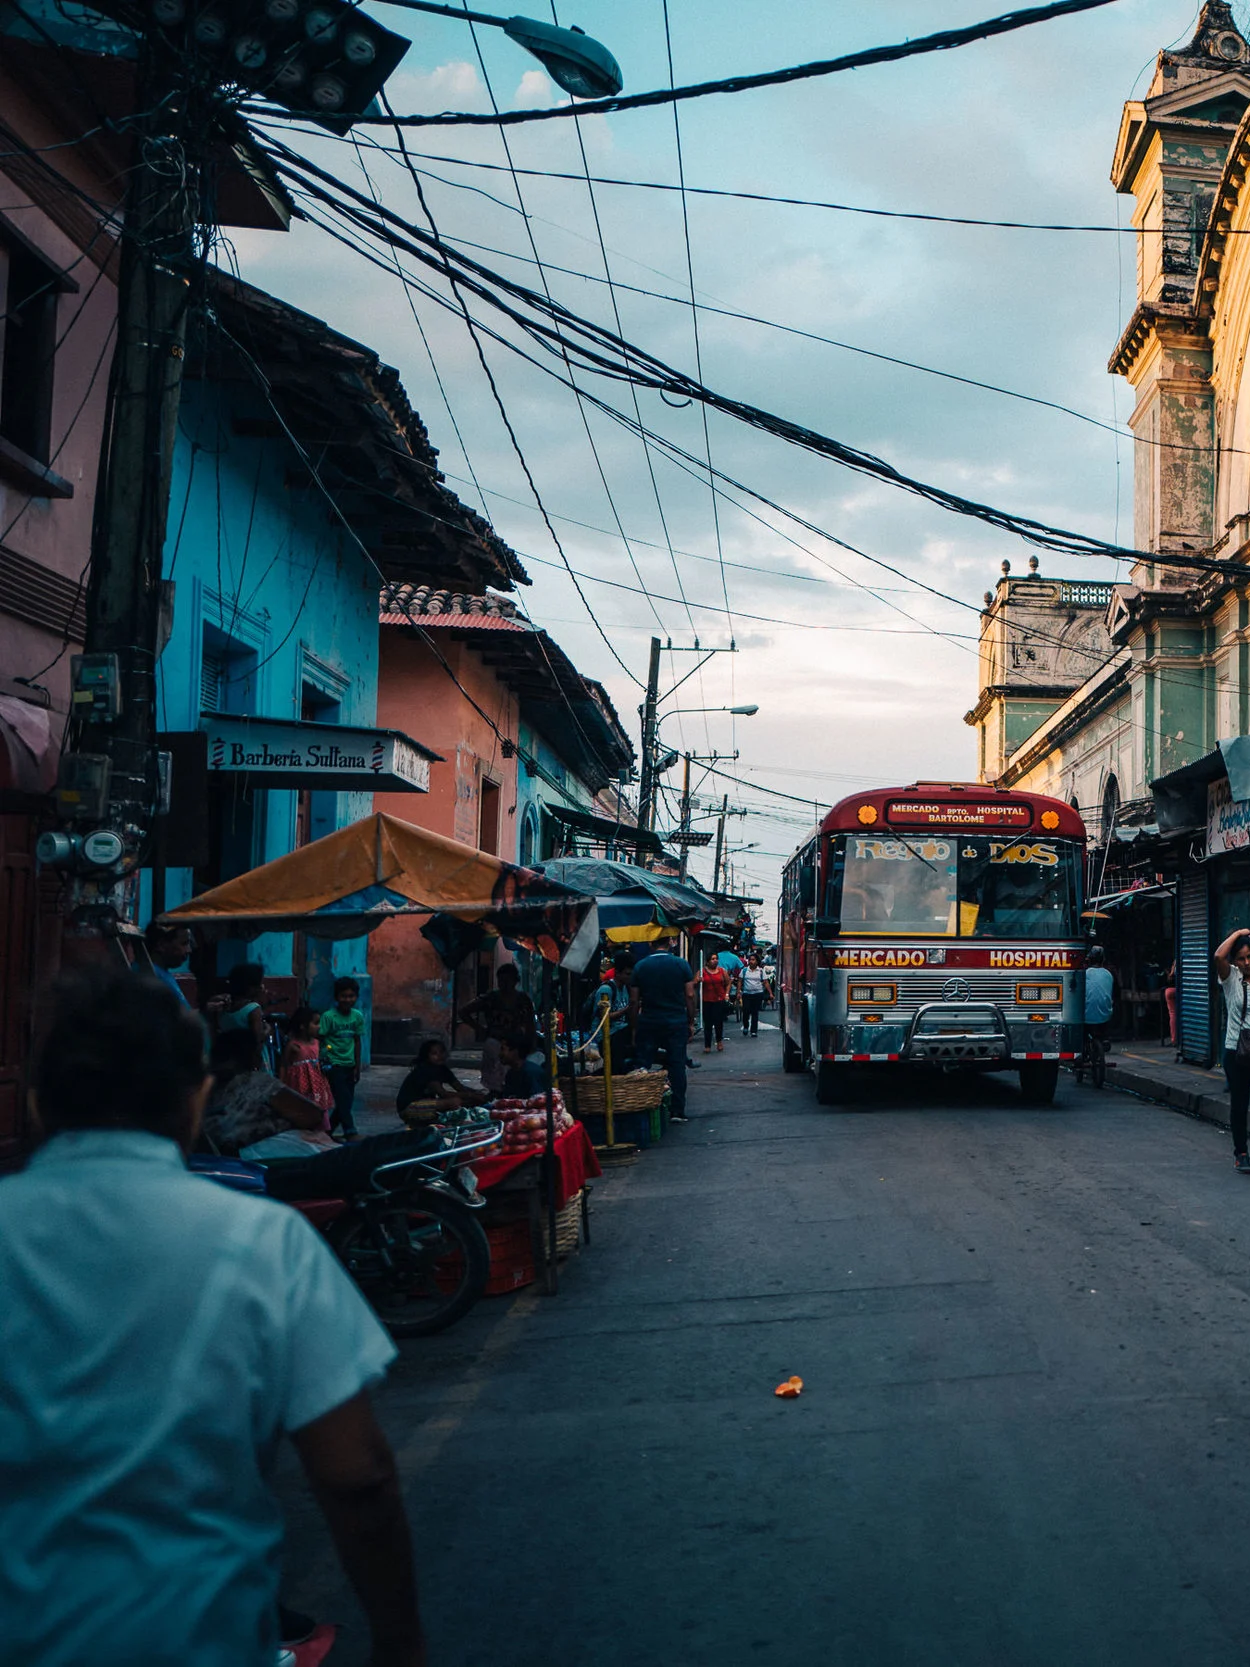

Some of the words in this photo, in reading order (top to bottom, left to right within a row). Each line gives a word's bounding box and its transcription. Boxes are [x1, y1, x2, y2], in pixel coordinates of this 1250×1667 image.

[305, 744, 366, 769] Sultana
[892, 804, 940, 813] MERCADO
[977, 806, 1025, 816] HOSPITAL
[928, 814, 985, 823] BARTOLOME
[855, 838, 950, 861] Regalo
[962, 846, 978, 858] de
[834, 950, 925, 967] MERCADO
[989, 951, 1071, 967] HOSPITAL
